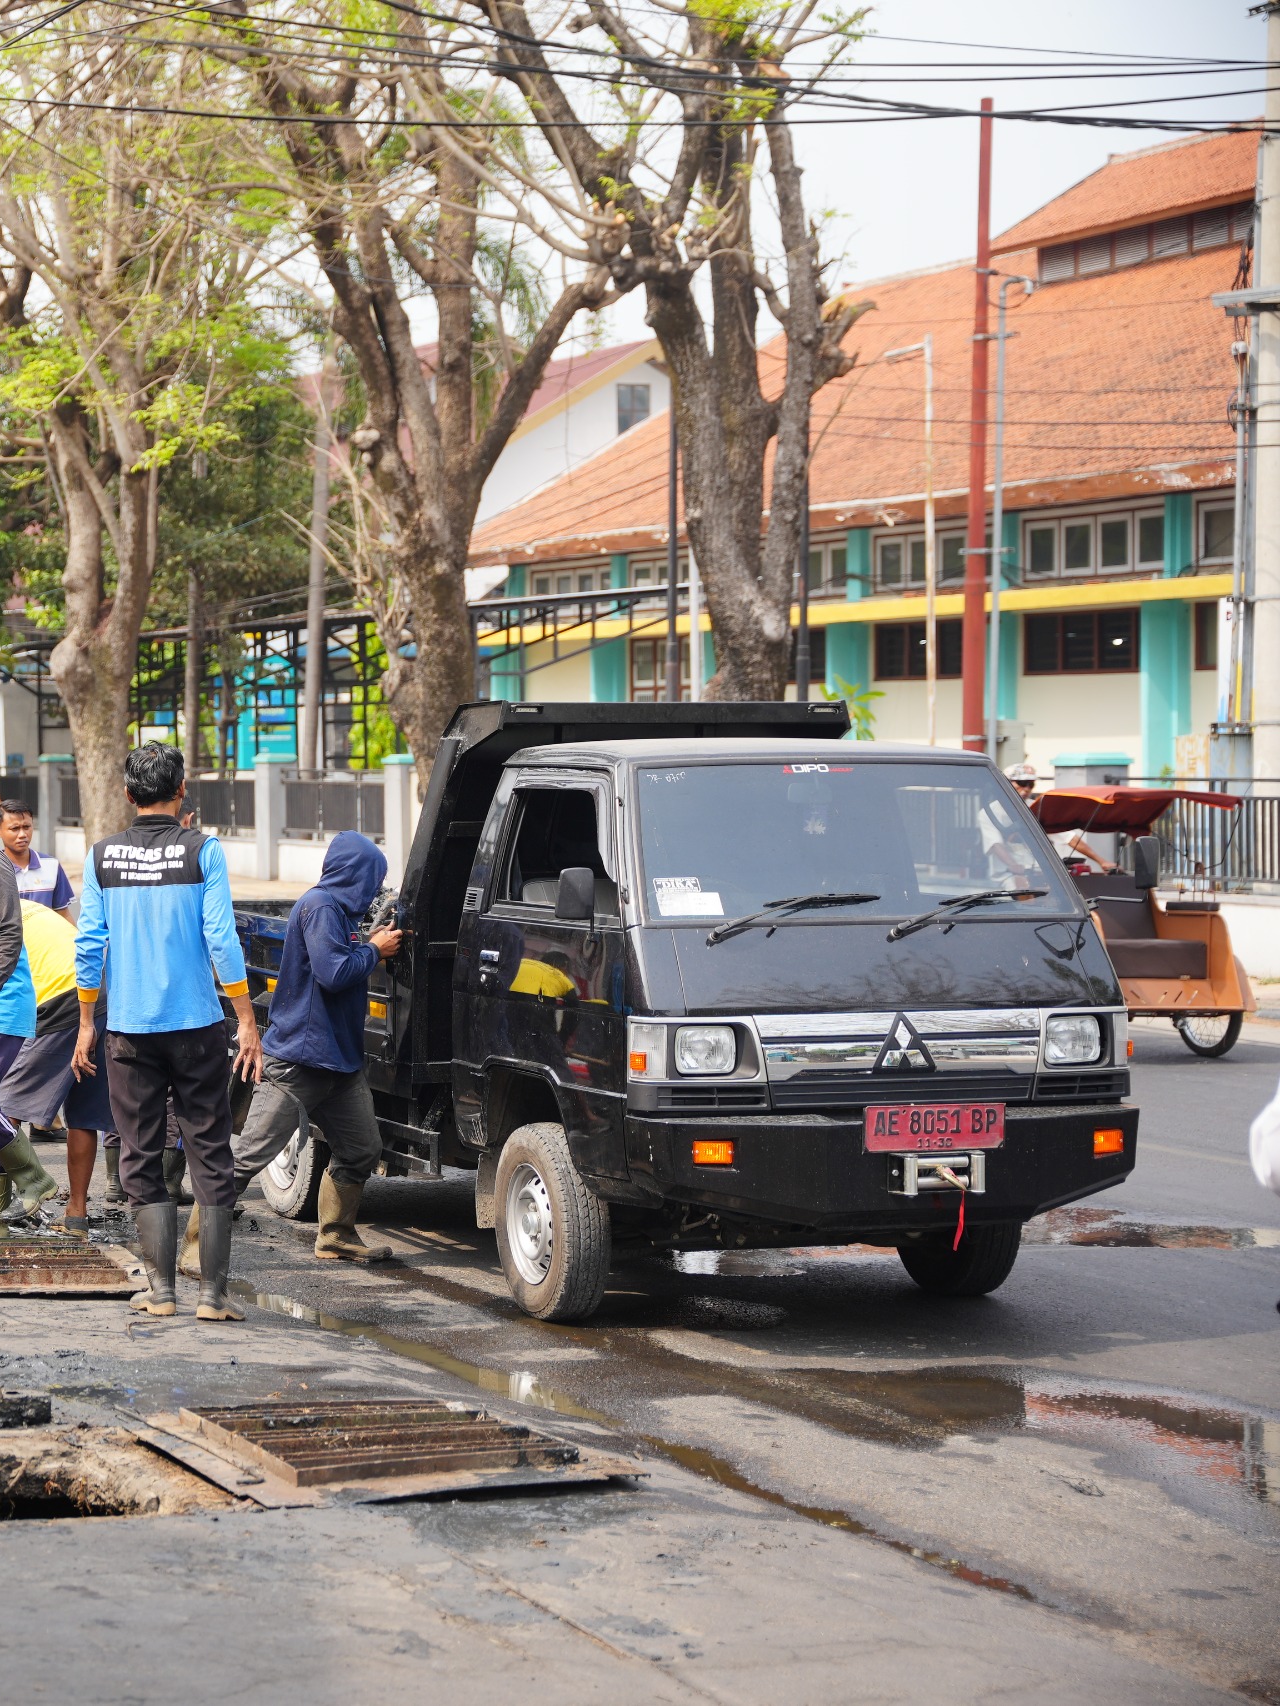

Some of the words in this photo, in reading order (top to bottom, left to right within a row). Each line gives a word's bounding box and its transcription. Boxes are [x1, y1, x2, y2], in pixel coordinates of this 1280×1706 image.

[791, 763, 830, 773] DIPO
[103, 844, 162, 862] PETUGAS
[165, 844, 186, 859] OP
[168, 860, 184, 869] SOLO
[874, 1109, 900, 1137] AE
[909, 1109, 962, 1135] 8051
[971, 1108, 998, 1134] BP
